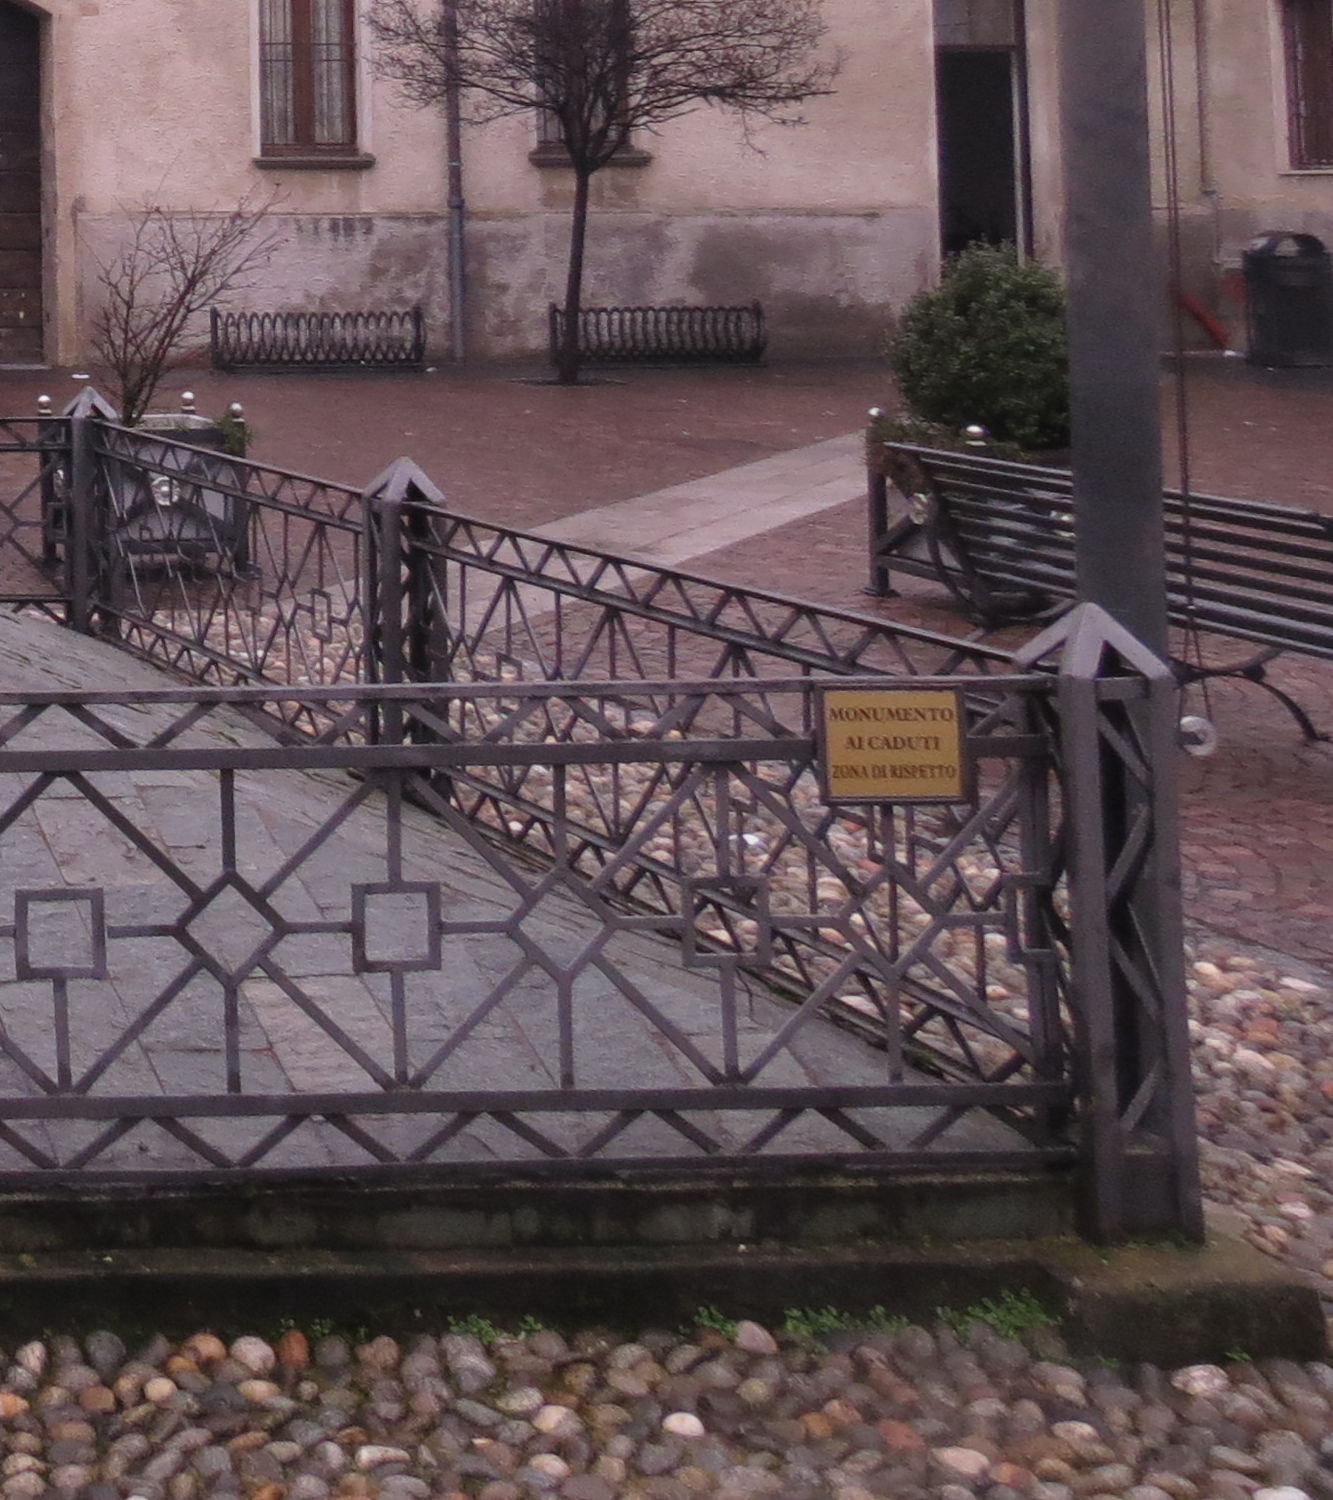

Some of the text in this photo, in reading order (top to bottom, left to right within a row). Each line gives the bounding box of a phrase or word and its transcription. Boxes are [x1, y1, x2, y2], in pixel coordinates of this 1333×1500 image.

[829, 707, 955, 723] MONUMENTO
[846, 736, 941, 751] AI CADUTI
[832, 764, 956, 780] ZONA DI RISPETTO
